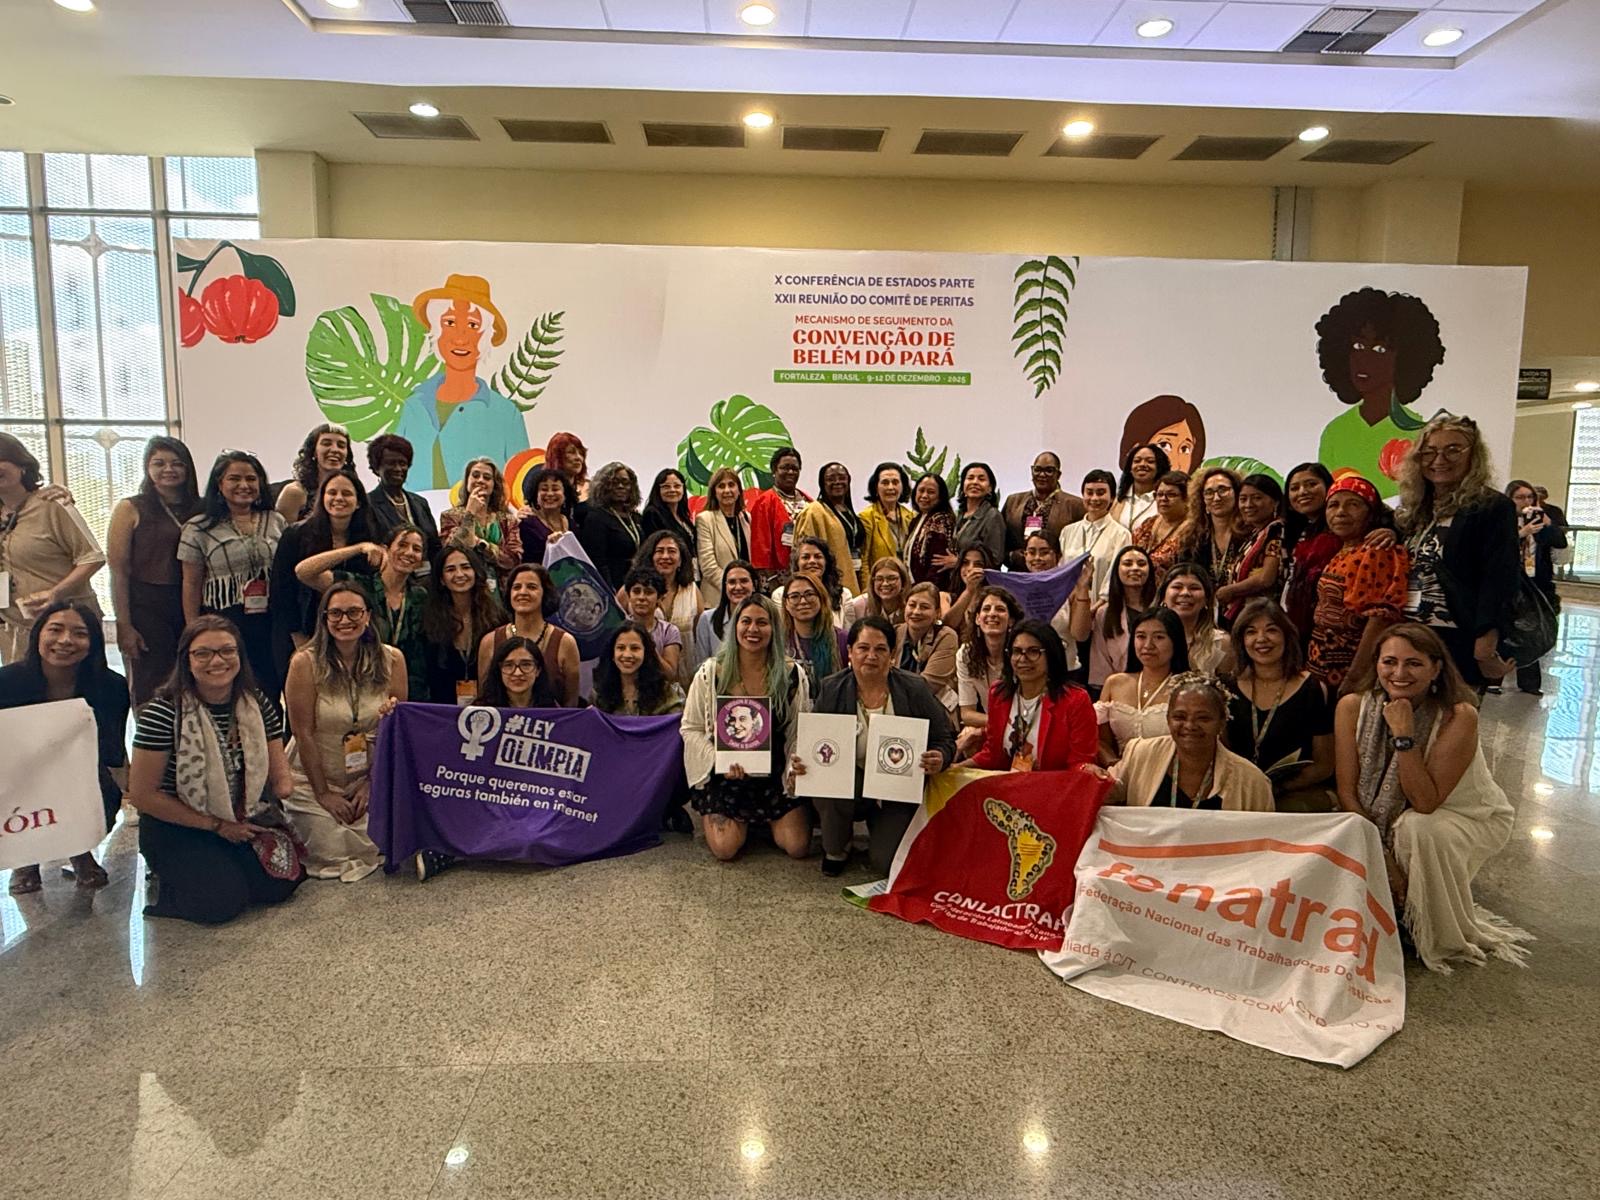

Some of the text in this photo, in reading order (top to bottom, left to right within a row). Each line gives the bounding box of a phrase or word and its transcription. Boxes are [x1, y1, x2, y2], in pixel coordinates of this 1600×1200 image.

[775, 274, 975, 288] X CONFERÊNCIA DE ESTADOS PARTE
[775, 292, 974, 307] XXII REUNIÃO DO COMITÊ DE PERITAS
[795, 315, 953, 326] MECANISMO DE SEGUIMENTO DA
[793, 327, 955, 349] CONVENÇÃO DE
[793, 345, 954, 366] BELÉM DO PARÁ
[780, 373, 825, 381] FORTALEZA
[832, 373, 860, 381] BRASIL
[504, 714, 556, 739] #LEY
[501, 737, 585, 779] OLIMPIA
[436, 765, 485, 787] Porque
[488, 776, 555, 796] queremos
[475, 789, 530, 807] también
[533, 799, 550, 810] en
[1, 806, 58, 834] ón
[1079, 886, 1142, 914] Federação
[1145, 907, 1203, 938] Nacional
[1206, 931, 1231, 948] das
[1237, 939, 1331, 974] Trabalhadoras
[1142, 968, 1238, 1001] CONTRACS
